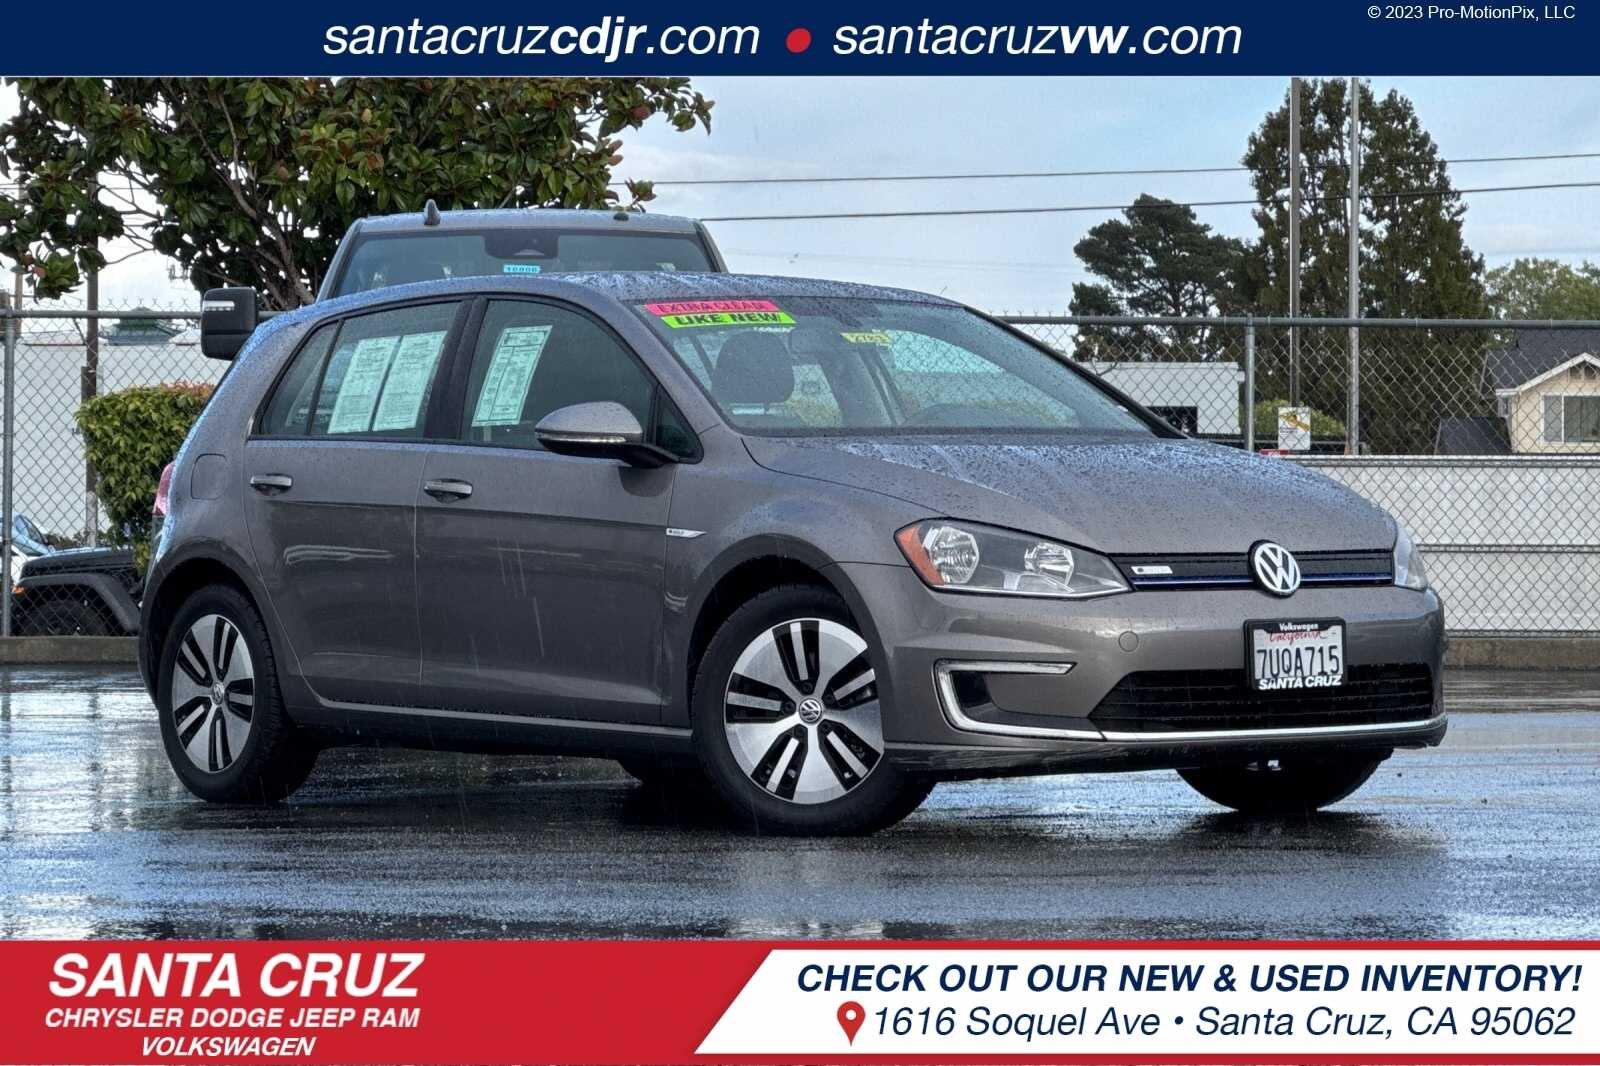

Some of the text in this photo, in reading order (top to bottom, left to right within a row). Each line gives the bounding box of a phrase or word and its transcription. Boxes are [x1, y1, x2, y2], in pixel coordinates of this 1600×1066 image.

[674, 311, 780, 326] LIKE NEW
[1279, 622, 1319, 632] Volkswagen
[1256, 645, 1340, 678] 7UQA715
[1258, 675, 1342, 690] SANTA CRUZ
